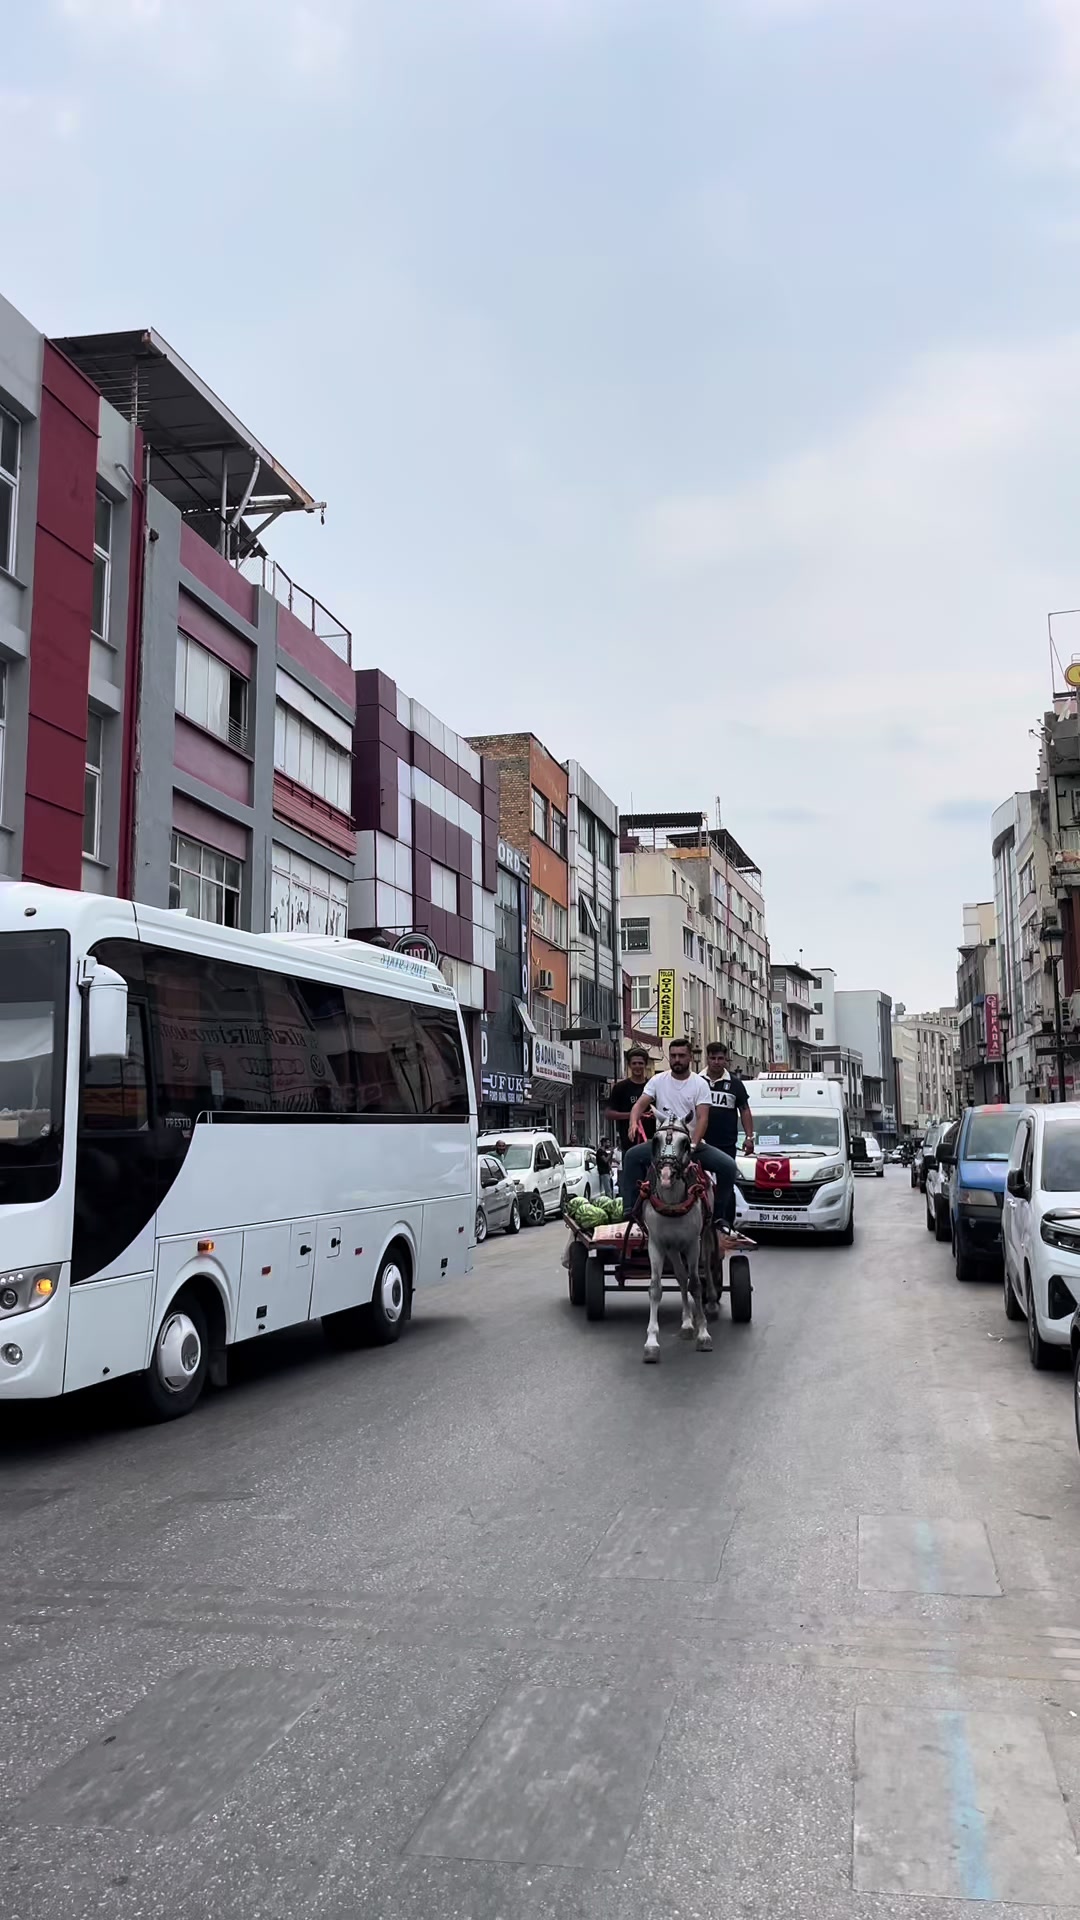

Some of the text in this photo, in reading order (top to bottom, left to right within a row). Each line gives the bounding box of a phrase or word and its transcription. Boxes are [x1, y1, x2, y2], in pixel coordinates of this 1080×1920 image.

[404, 948, 426, 960] FIAT
[661, 978, 671, 1035] OTO AKSESUAR
[490, 1074, 523, 1091] UFUK
